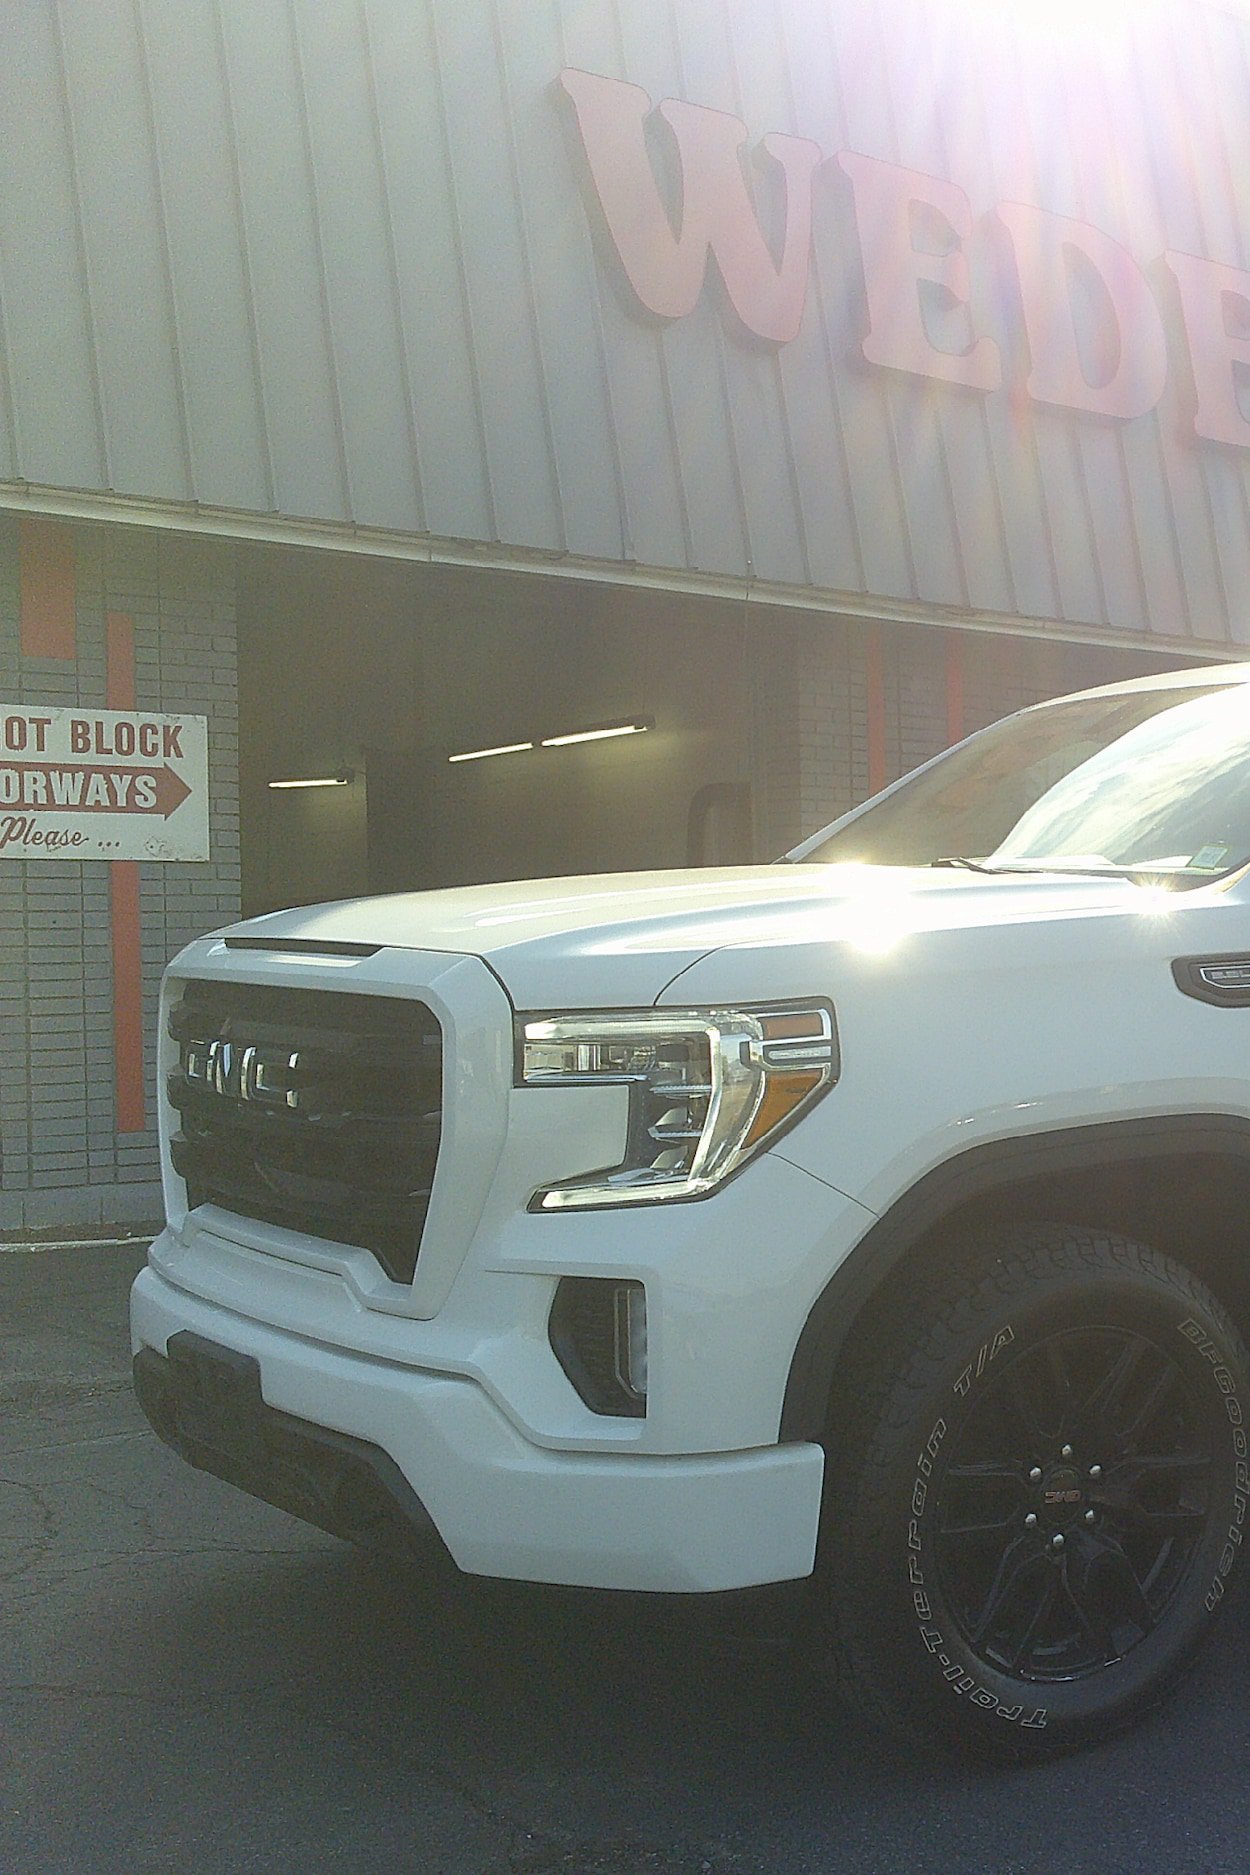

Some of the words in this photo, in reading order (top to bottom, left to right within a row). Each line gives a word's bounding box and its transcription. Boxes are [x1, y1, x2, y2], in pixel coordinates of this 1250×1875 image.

[4, 715, 52, 752] OT
[70, 719, 184, 759] BLOCK
[0, 767, 158, 809] ORWAYS
[952, 1325, 1015, 1397] T/A
